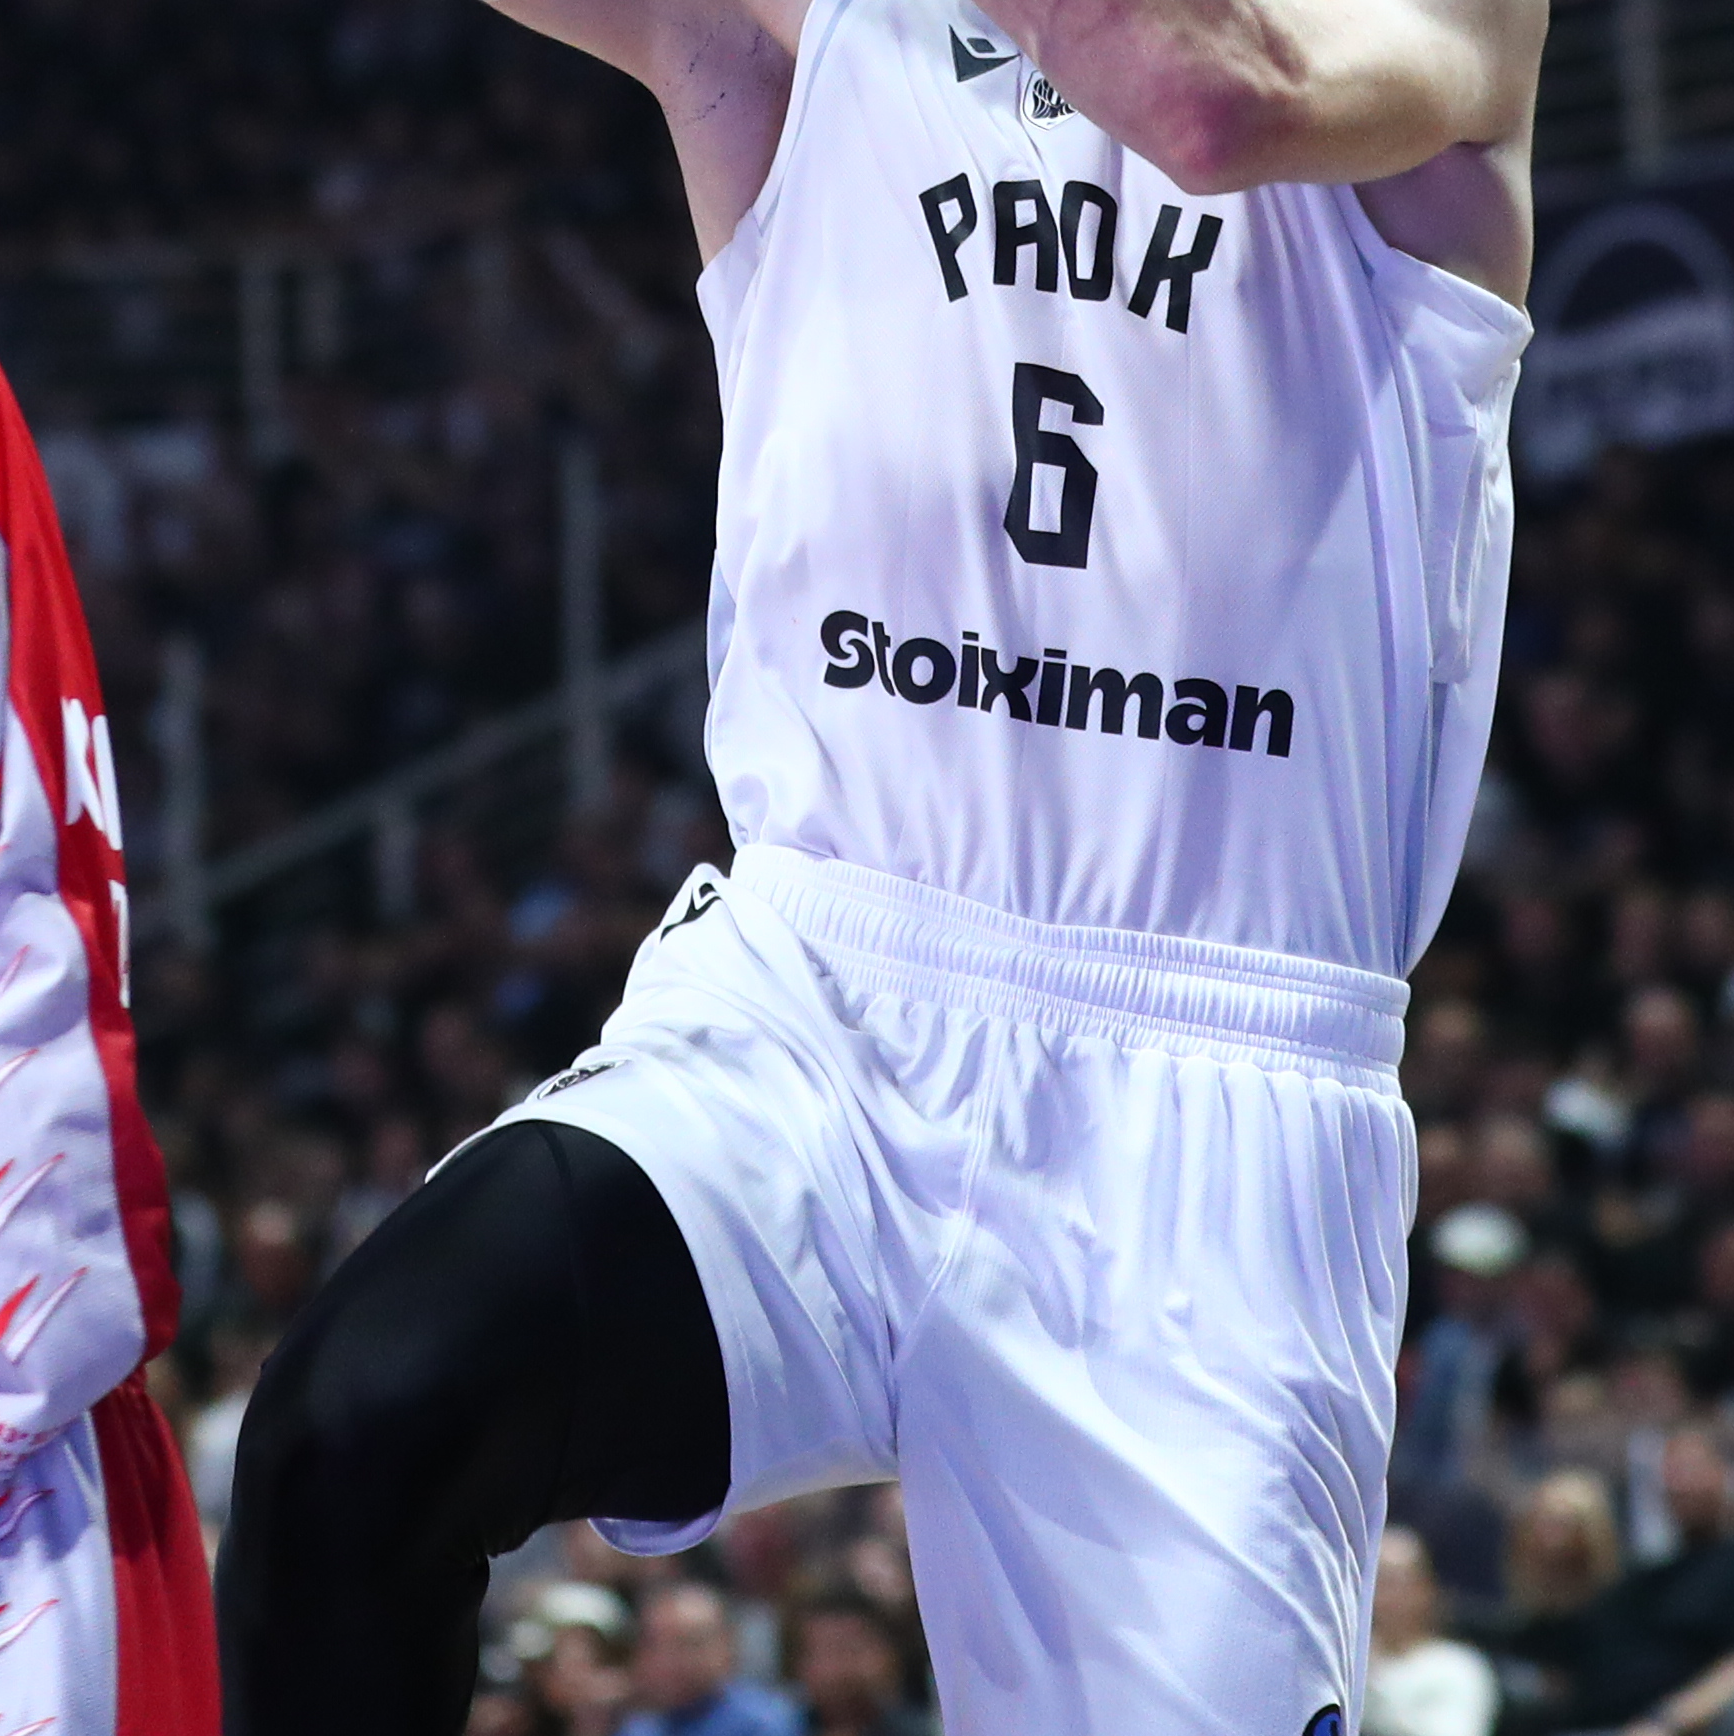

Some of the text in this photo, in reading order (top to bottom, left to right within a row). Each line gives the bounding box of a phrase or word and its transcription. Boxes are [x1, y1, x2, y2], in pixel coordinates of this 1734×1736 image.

[919, 173, 1223, 335] PAOK
[1003, 362, 1105, 569] 6
[821, 609, 1295, 758] Stoiximan
